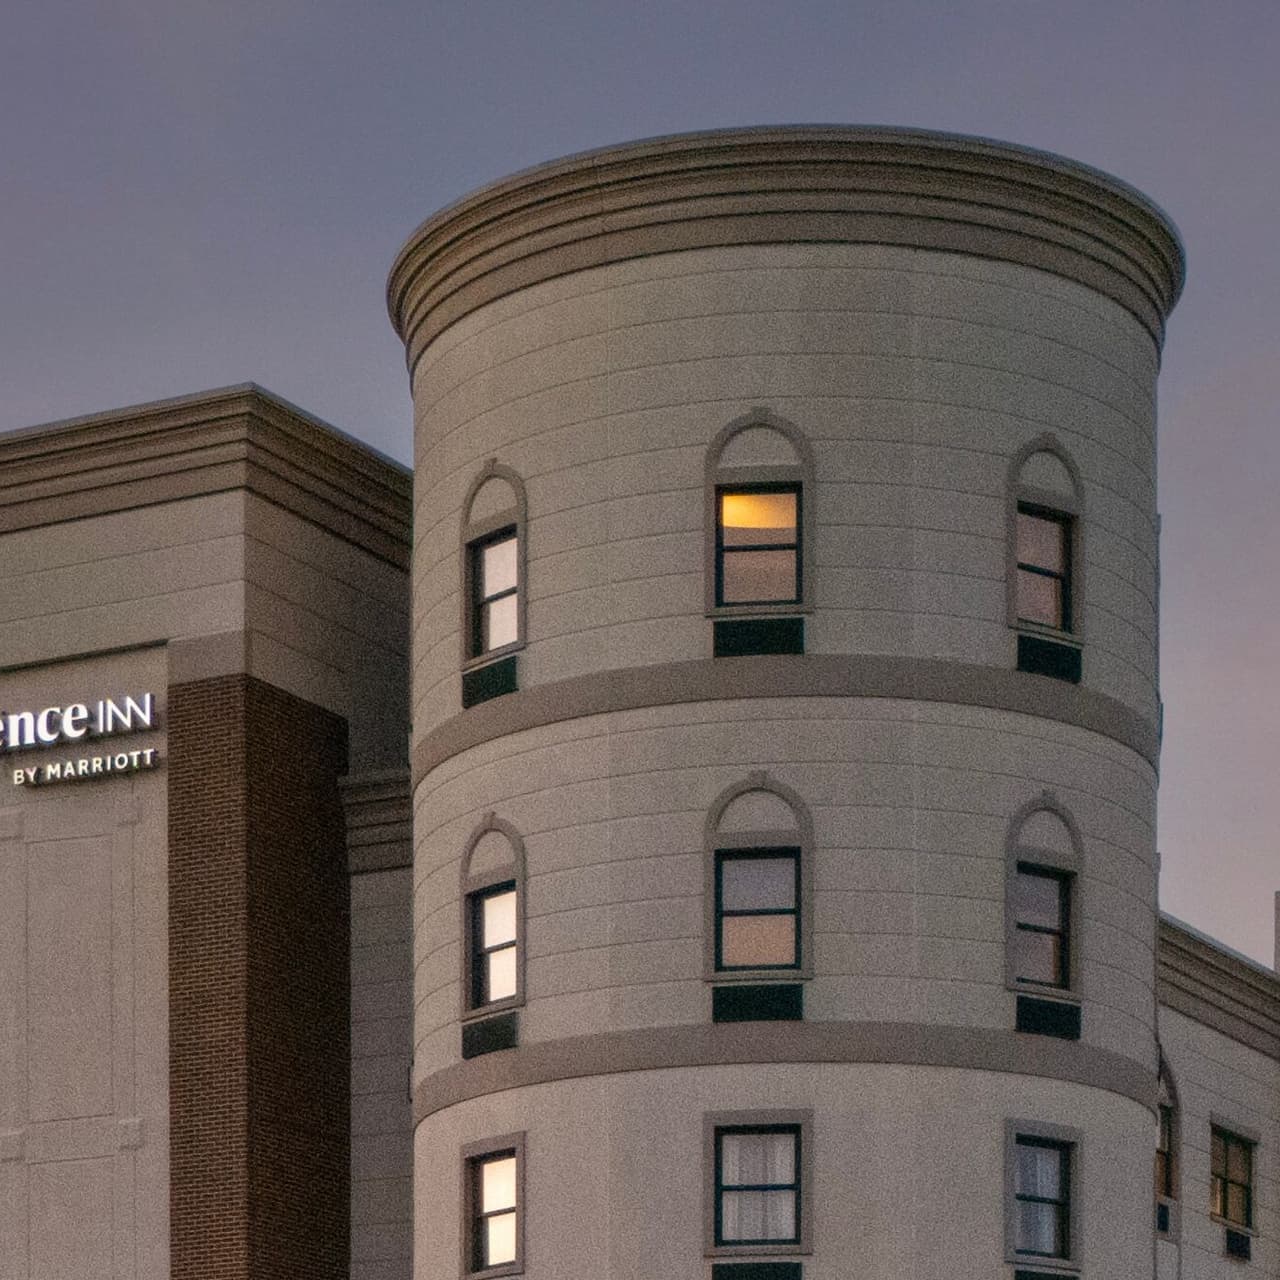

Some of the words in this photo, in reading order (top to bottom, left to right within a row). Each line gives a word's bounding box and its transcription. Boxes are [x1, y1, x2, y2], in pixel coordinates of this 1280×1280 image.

[99, 693, 152, 733] INN
[14, 767, 37, 784] BY
[47, 749, 155, 780] MARRIOTT
